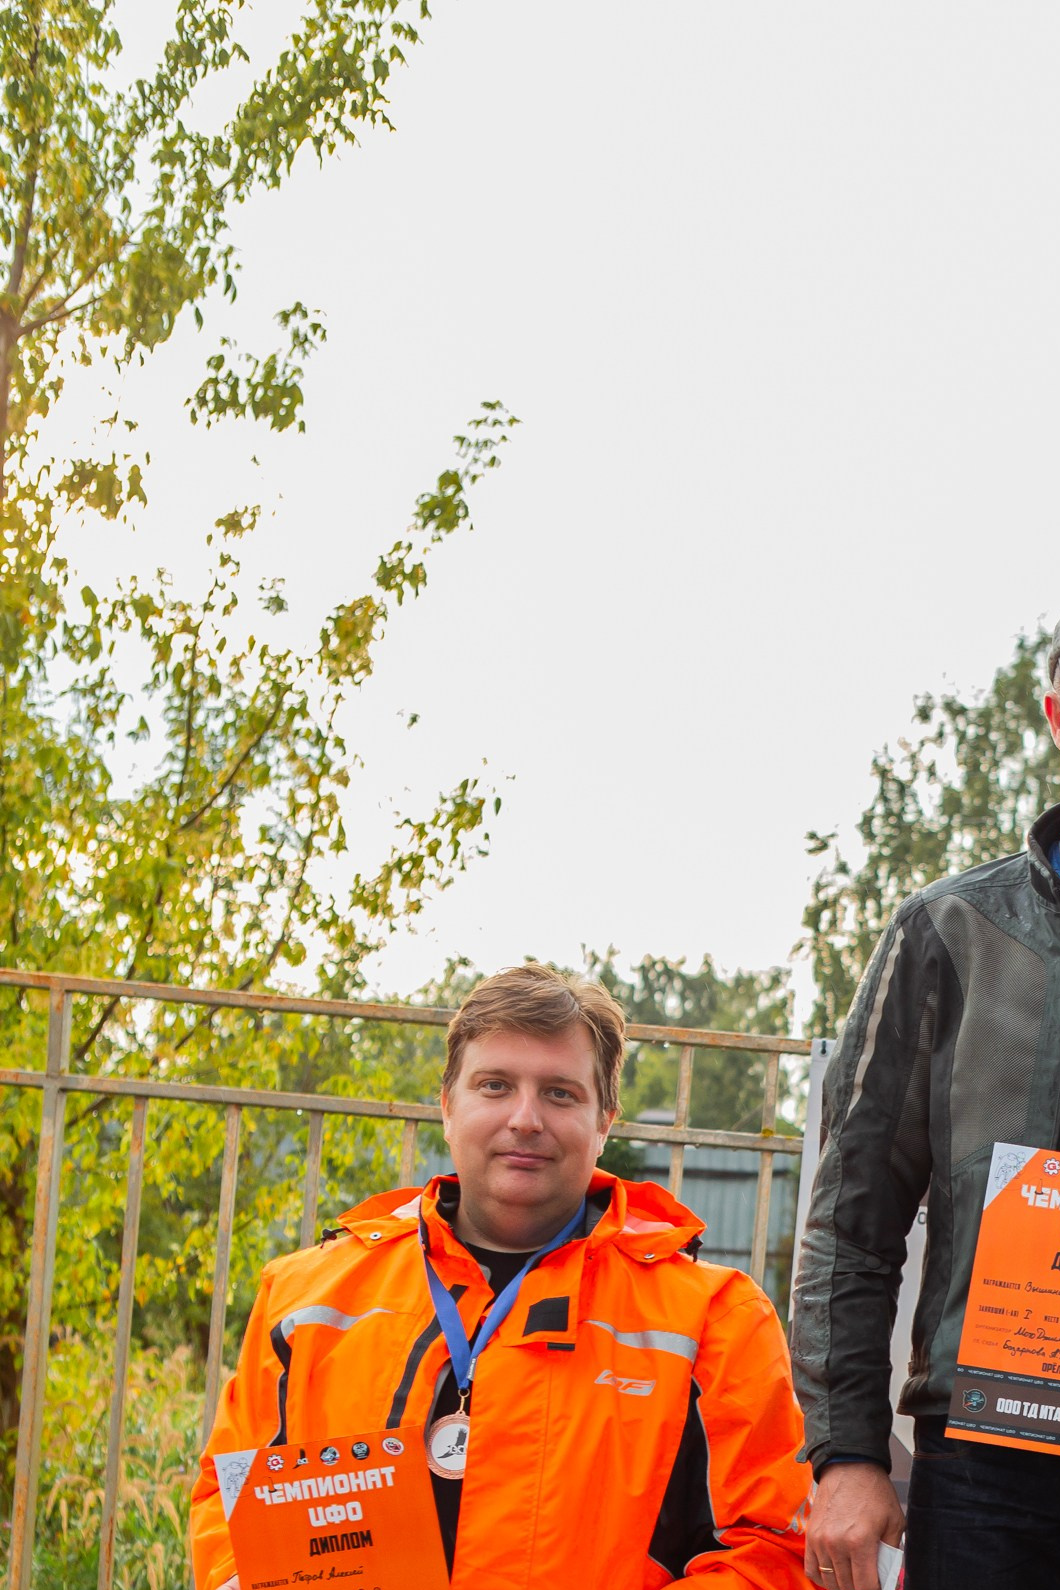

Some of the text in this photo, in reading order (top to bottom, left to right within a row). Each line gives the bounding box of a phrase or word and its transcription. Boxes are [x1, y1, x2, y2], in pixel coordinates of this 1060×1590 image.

[996, 1398, 1060, 1422] ООО ТД ИТА
[254, 1466, 395, 1505] ЧЕМПИОНАТ
[308, 1501, 362, 1527] ЦФО
[309, 1530, 373, 1557] ДИПЛОМ
